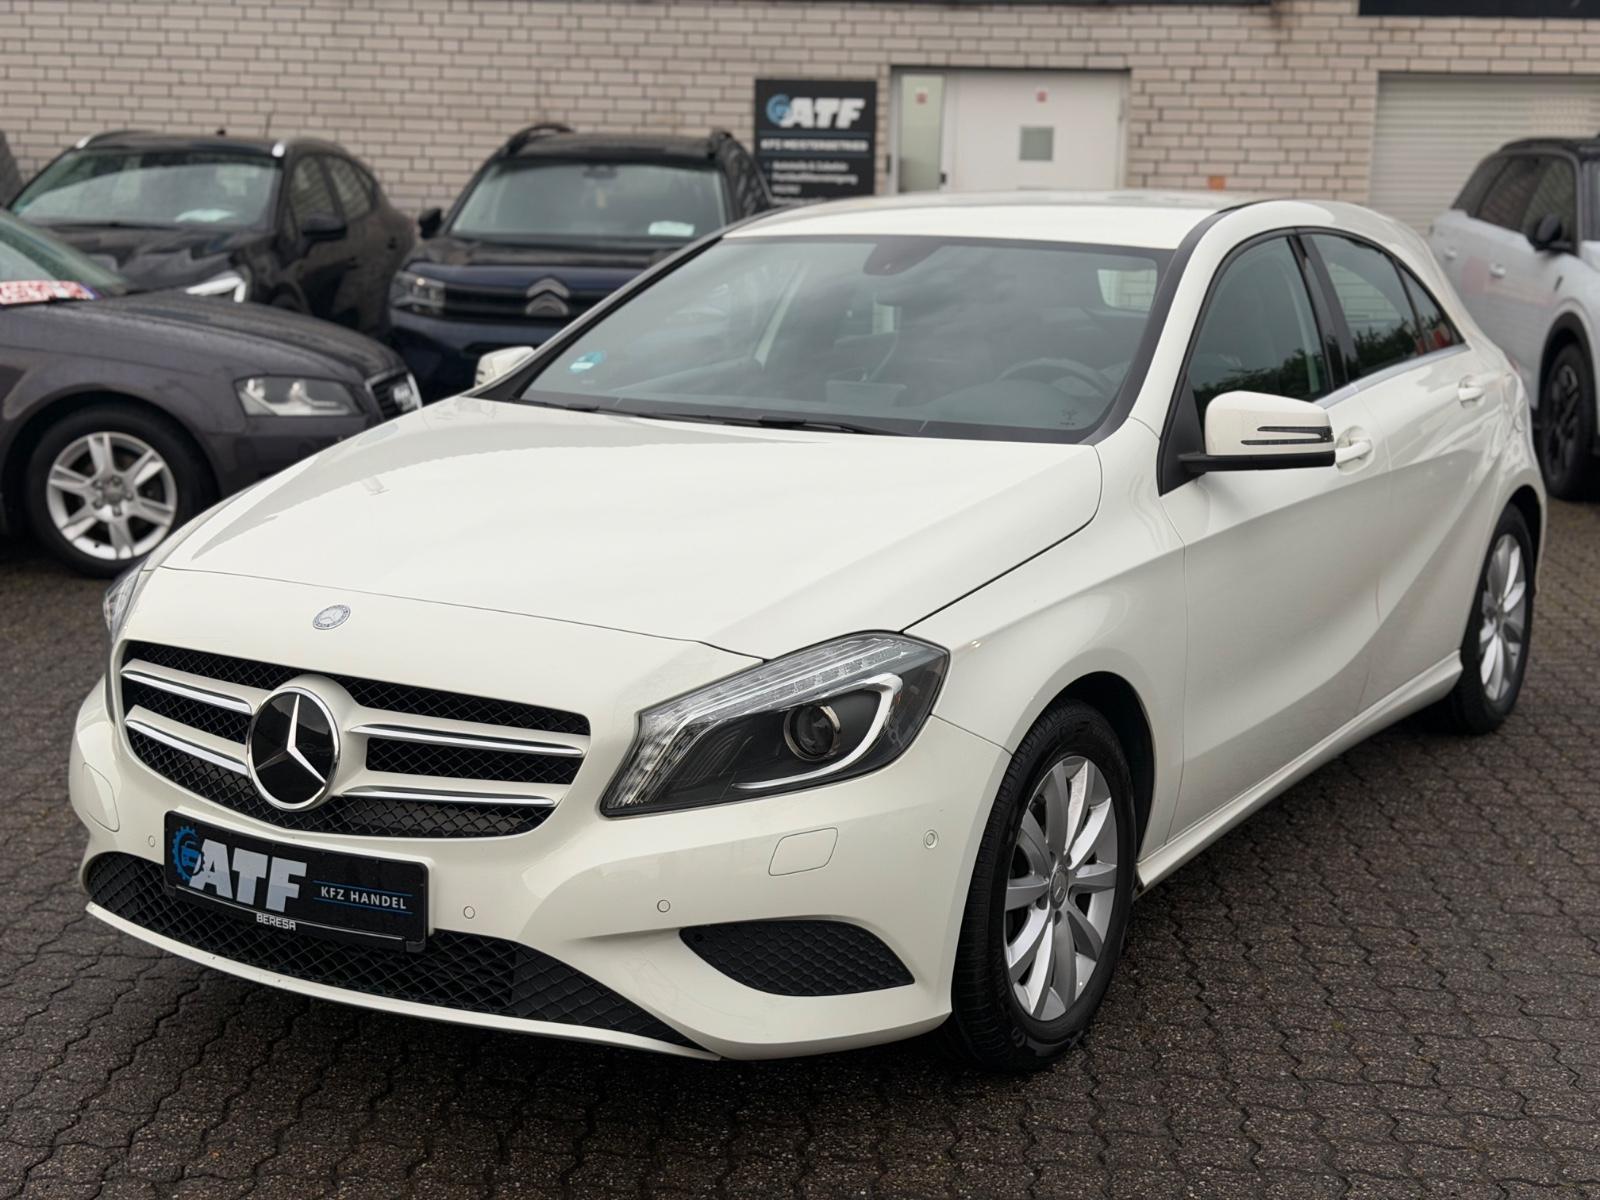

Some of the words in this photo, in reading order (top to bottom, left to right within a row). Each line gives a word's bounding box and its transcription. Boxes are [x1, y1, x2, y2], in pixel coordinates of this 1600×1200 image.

[779, 97, 866, 129] ATF
[188, 838, 307, 913] ATF
[320, 886, 344, 900] KFZ
[350, 890, 407, 909] HANDEL
[256, 912, 296, 931] BERESA
